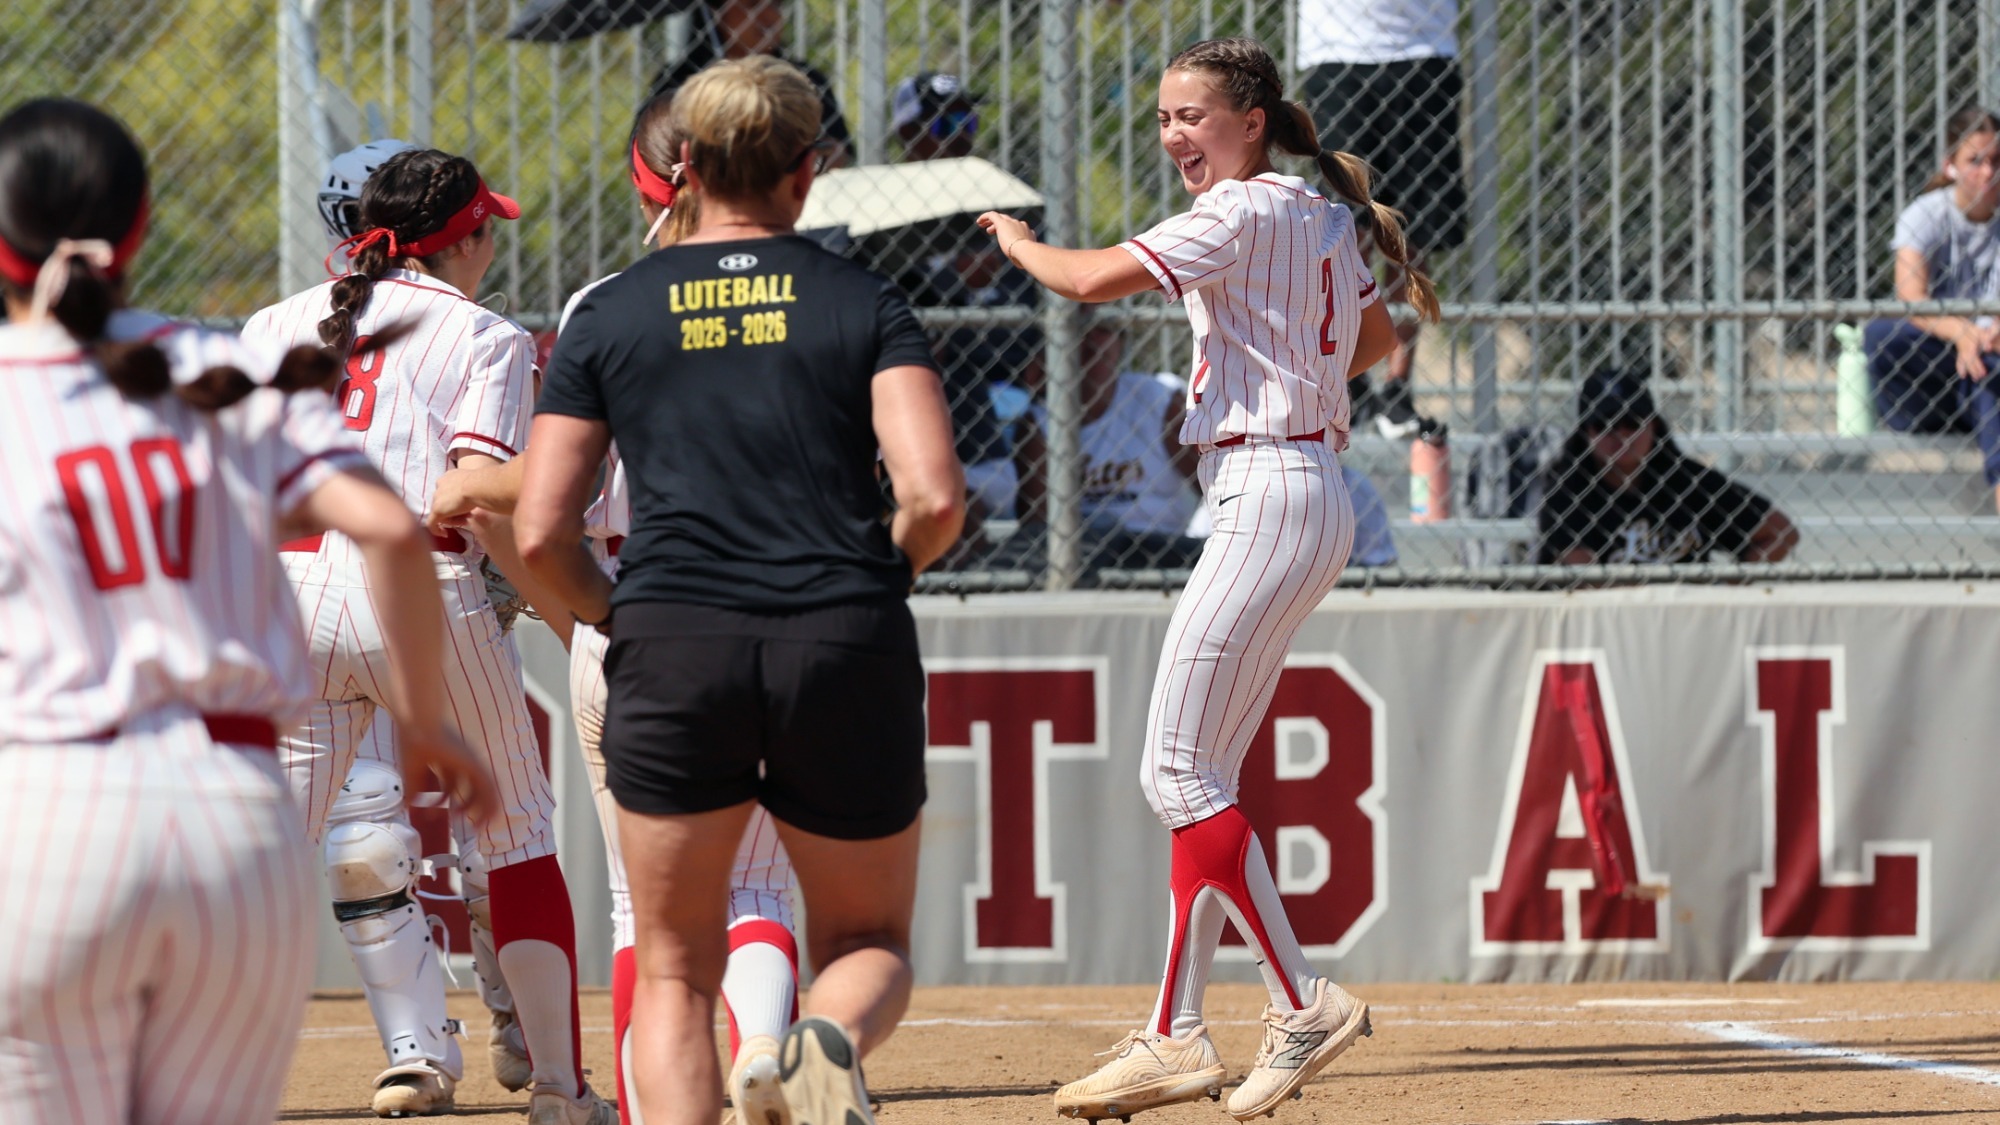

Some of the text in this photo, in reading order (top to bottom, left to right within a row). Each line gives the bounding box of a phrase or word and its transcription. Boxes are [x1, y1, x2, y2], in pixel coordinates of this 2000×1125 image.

[669, 273, 797, 313] LUTEBALL
[1319, 257, 1337, 356] 2
[681, 315, 727, 350] 2025
[741, 310, 787, 345] 2026
[55, 437, 195, 590] 00
